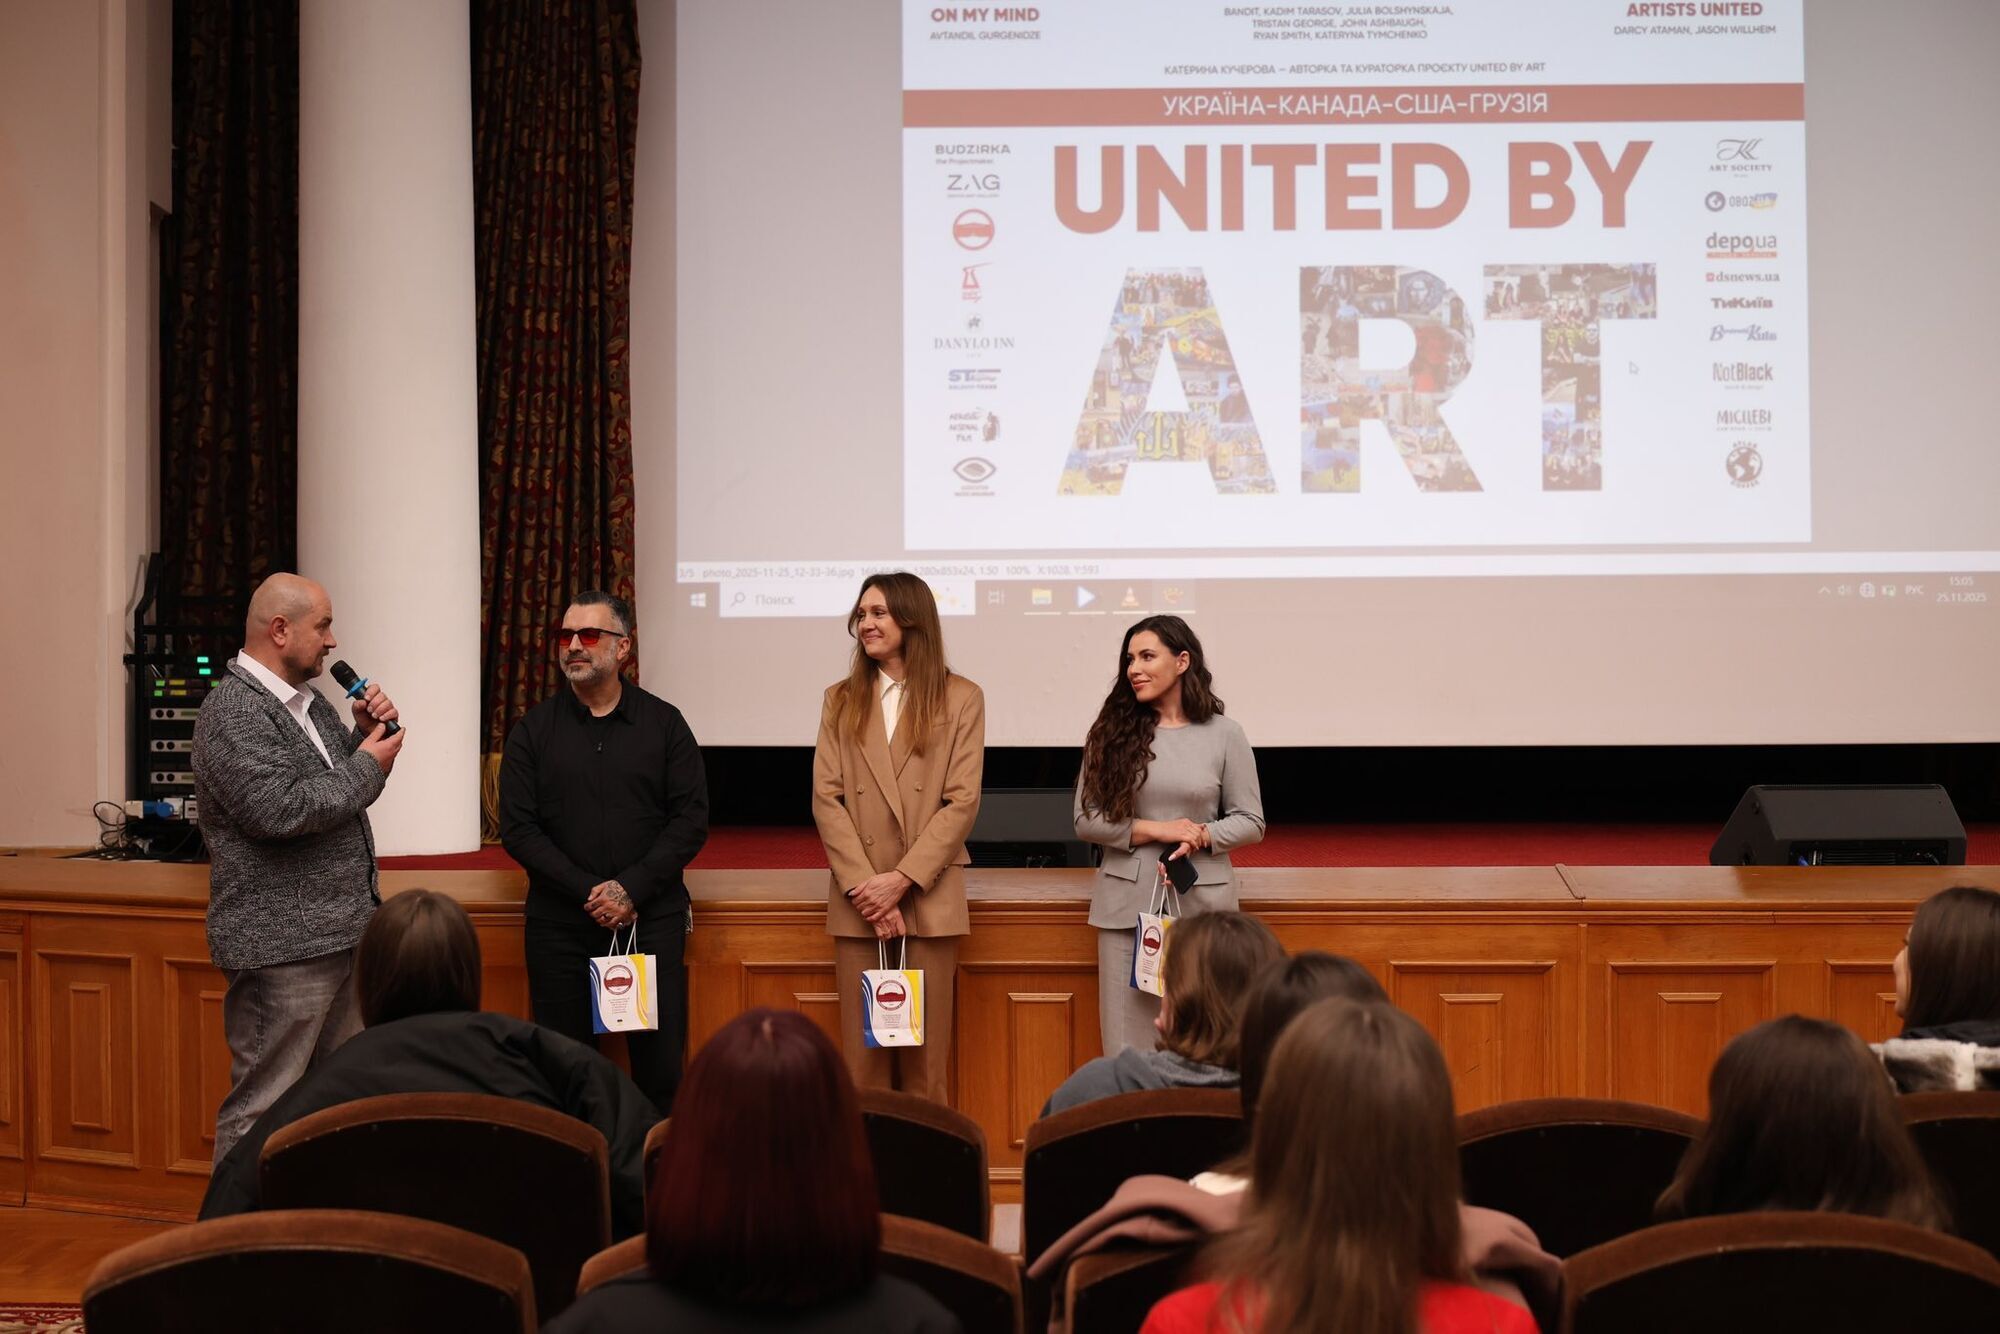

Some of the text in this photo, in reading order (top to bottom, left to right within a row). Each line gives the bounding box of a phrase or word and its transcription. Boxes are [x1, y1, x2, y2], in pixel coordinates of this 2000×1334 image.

[931, 8, 1039, 22] ON MY MIND
[1224, 7, 1261, 16] BANDIT,
[1297, 7, 1343, 16] TARASOV,
[1346, 7, 1371, 15] JULIA
[1627, 2, 1763, 17] ARTISTS UNITED
[1252, 19, 1290, 27] TRISTAN
[1292, 19, 1337, 28] GEORGE,
[1339, 19, 1367, 27] JOHN
[1614, 24, 1776, 35] DARCY ATAMAN, JASON WILLHEIM
[930, 31, 976, 40] AVTANDIL
[1253, 31, 1279, 40] RYAN
[1281, 31, 1312, 41] SMITH,
[1315, 30, 1364, 39] KATERYNA
[1164, 65, 1218, 75] КАТЕРИНА
[1220, 65, 1276, 75] КУЧЕРОВА
[1289, 64, 1338, 74] АВТОРКА
[1341, 64, 1353, 73] ТА
[1355, 63, 1415, 74] КУРАТОРКА
[1417, 63, 1468, 73] ПРОЄКТУ
[1470, 63, 1508, 73] UNITED
[1510, 62, 1523, 72] BY
[1525, 62, 1546, 72] ART
[935, 144, 1011, 155] BUDZIRKA
[1709, 164, 1773, 172] ART SOCIETY
[1054, 140, 1654, 235] UNITED BY
[1716, 271, 1780, 282] dsnews.ua
[934, 337, 1015, 349] DANYLO INN
[1712, 362, 1773, 382] NotBlack
[1056, 263, 1658, 495] ART
[1006, 565, 1030, 576] 100%
[755, 594, 795, 606] Поиск
